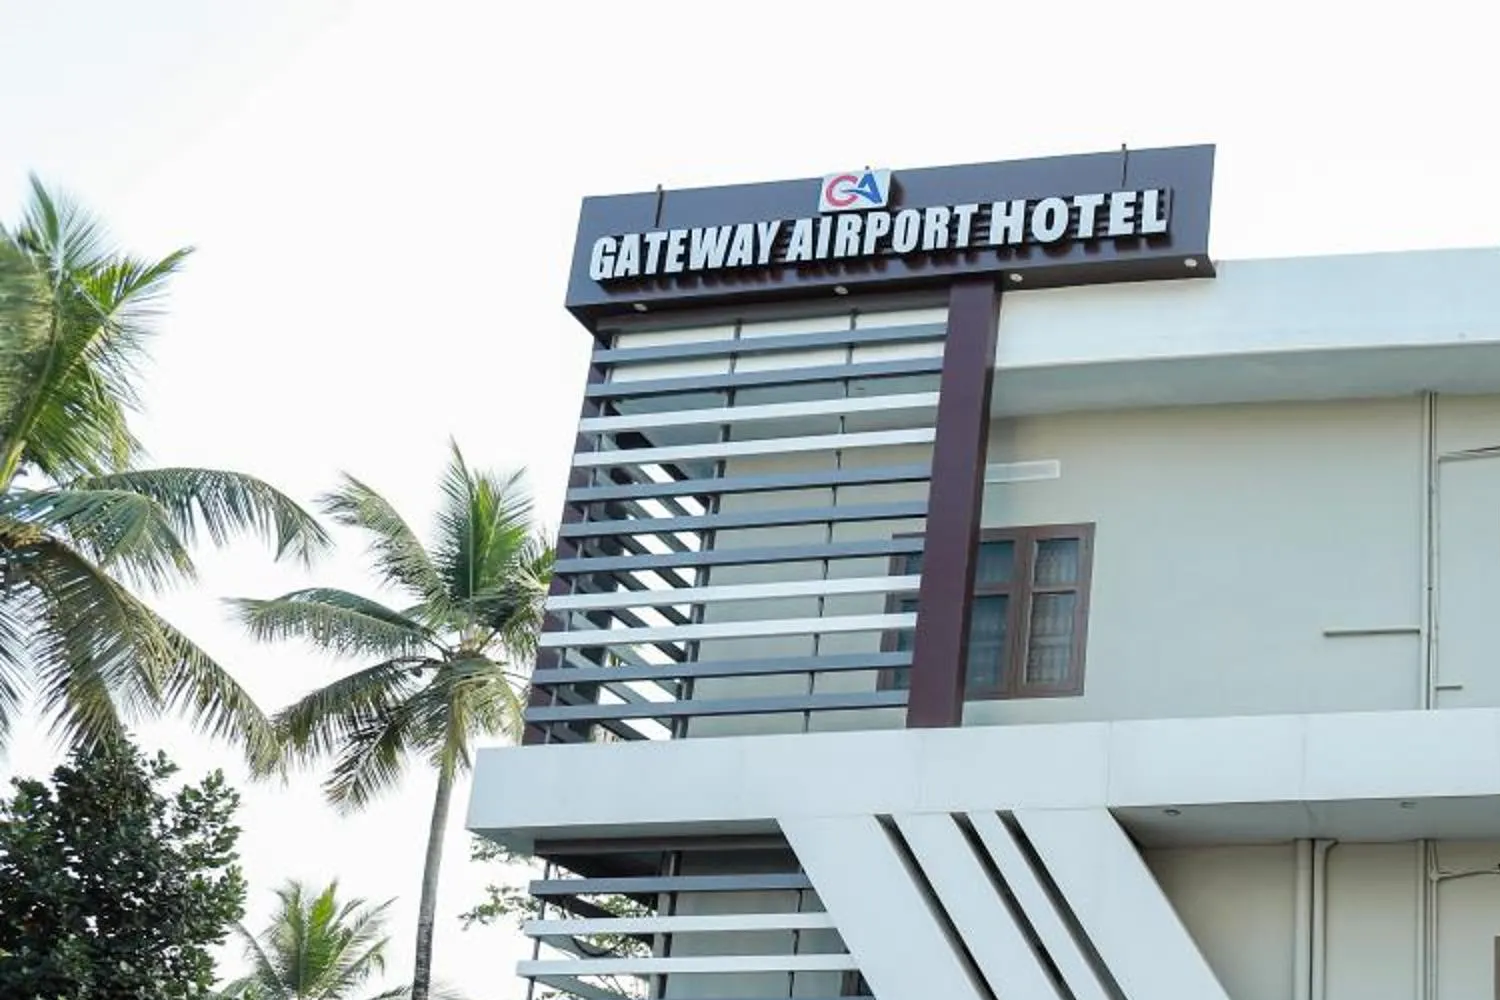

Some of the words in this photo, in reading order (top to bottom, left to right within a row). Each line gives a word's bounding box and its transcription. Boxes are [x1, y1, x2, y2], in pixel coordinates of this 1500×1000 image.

[589, 221, 783, 281] GATEWAY
[786, 203, 977, 262] AIRPORT
[988, 189, 1168, 244] HOTEL
